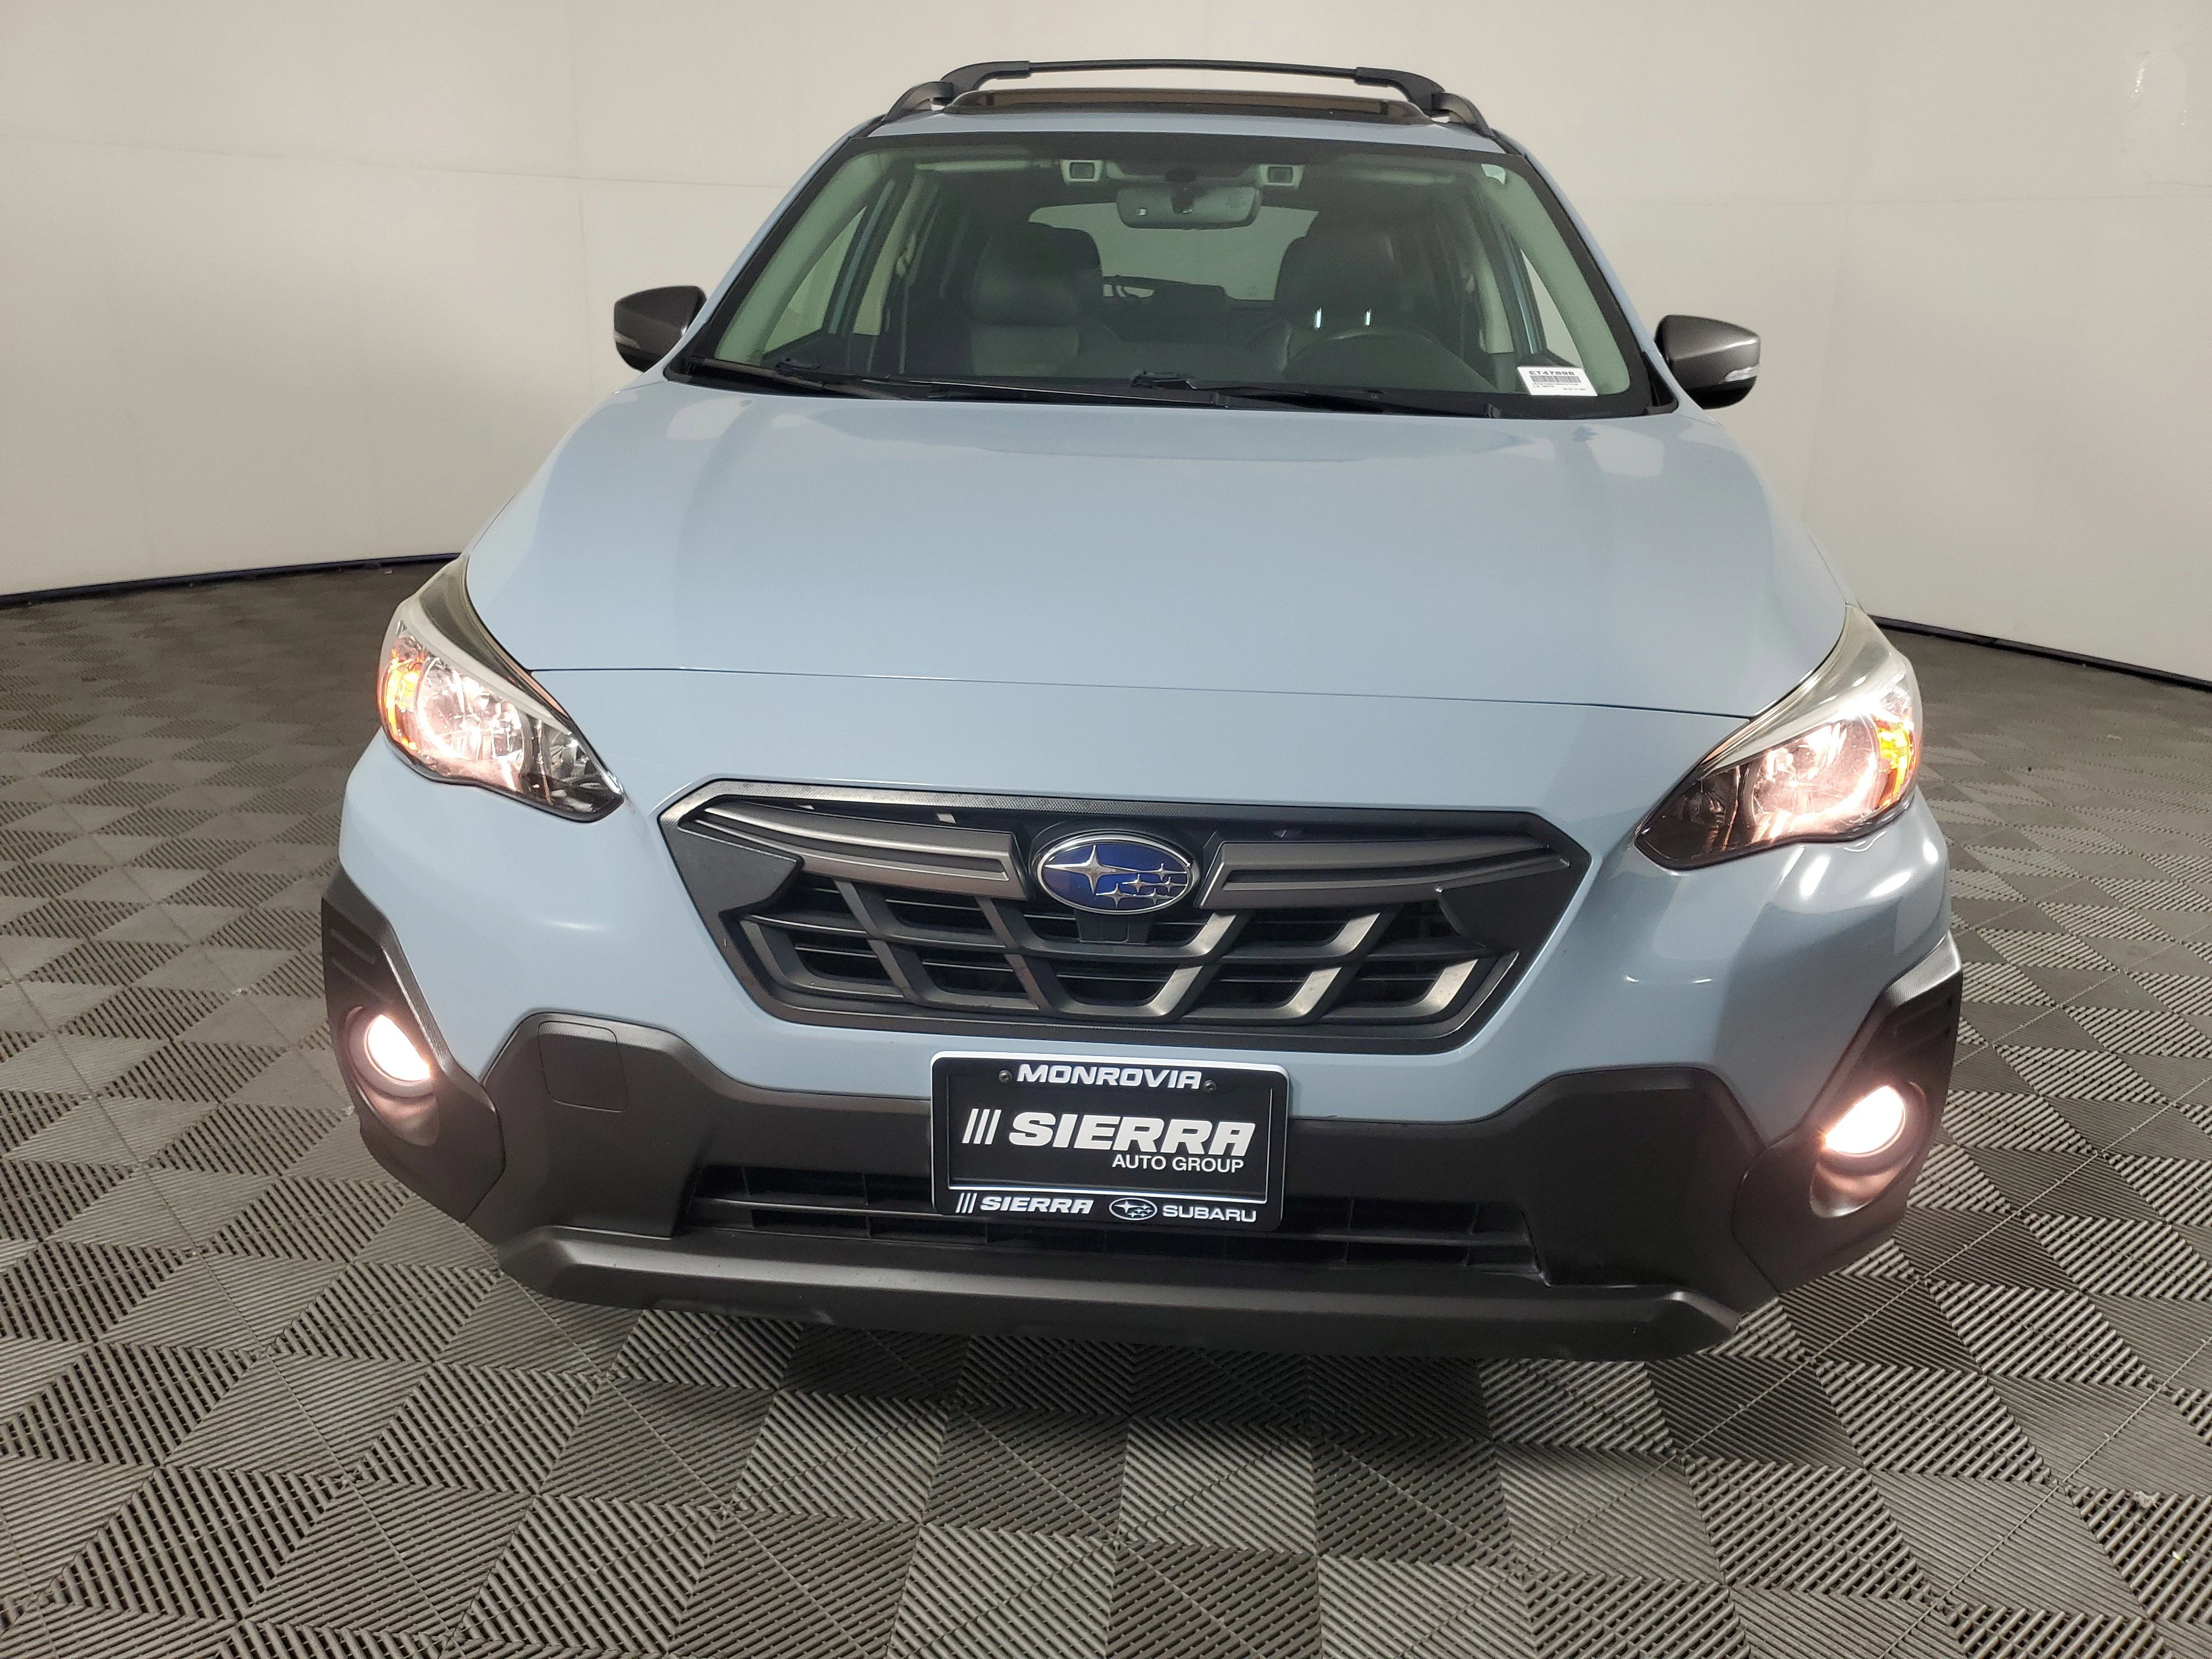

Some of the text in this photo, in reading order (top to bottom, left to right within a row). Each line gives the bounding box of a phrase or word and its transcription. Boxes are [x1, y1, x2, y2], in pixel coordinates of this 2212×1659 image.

[1016, 1063, 1203, 1090] MONROVIA
[1008, 1111, 1256, 1156] SIERRA
[1111, 1154, 1245, 1173] AUTO GROUP
[979, 1195, 1257, 1223] SIERRA SUBARU
